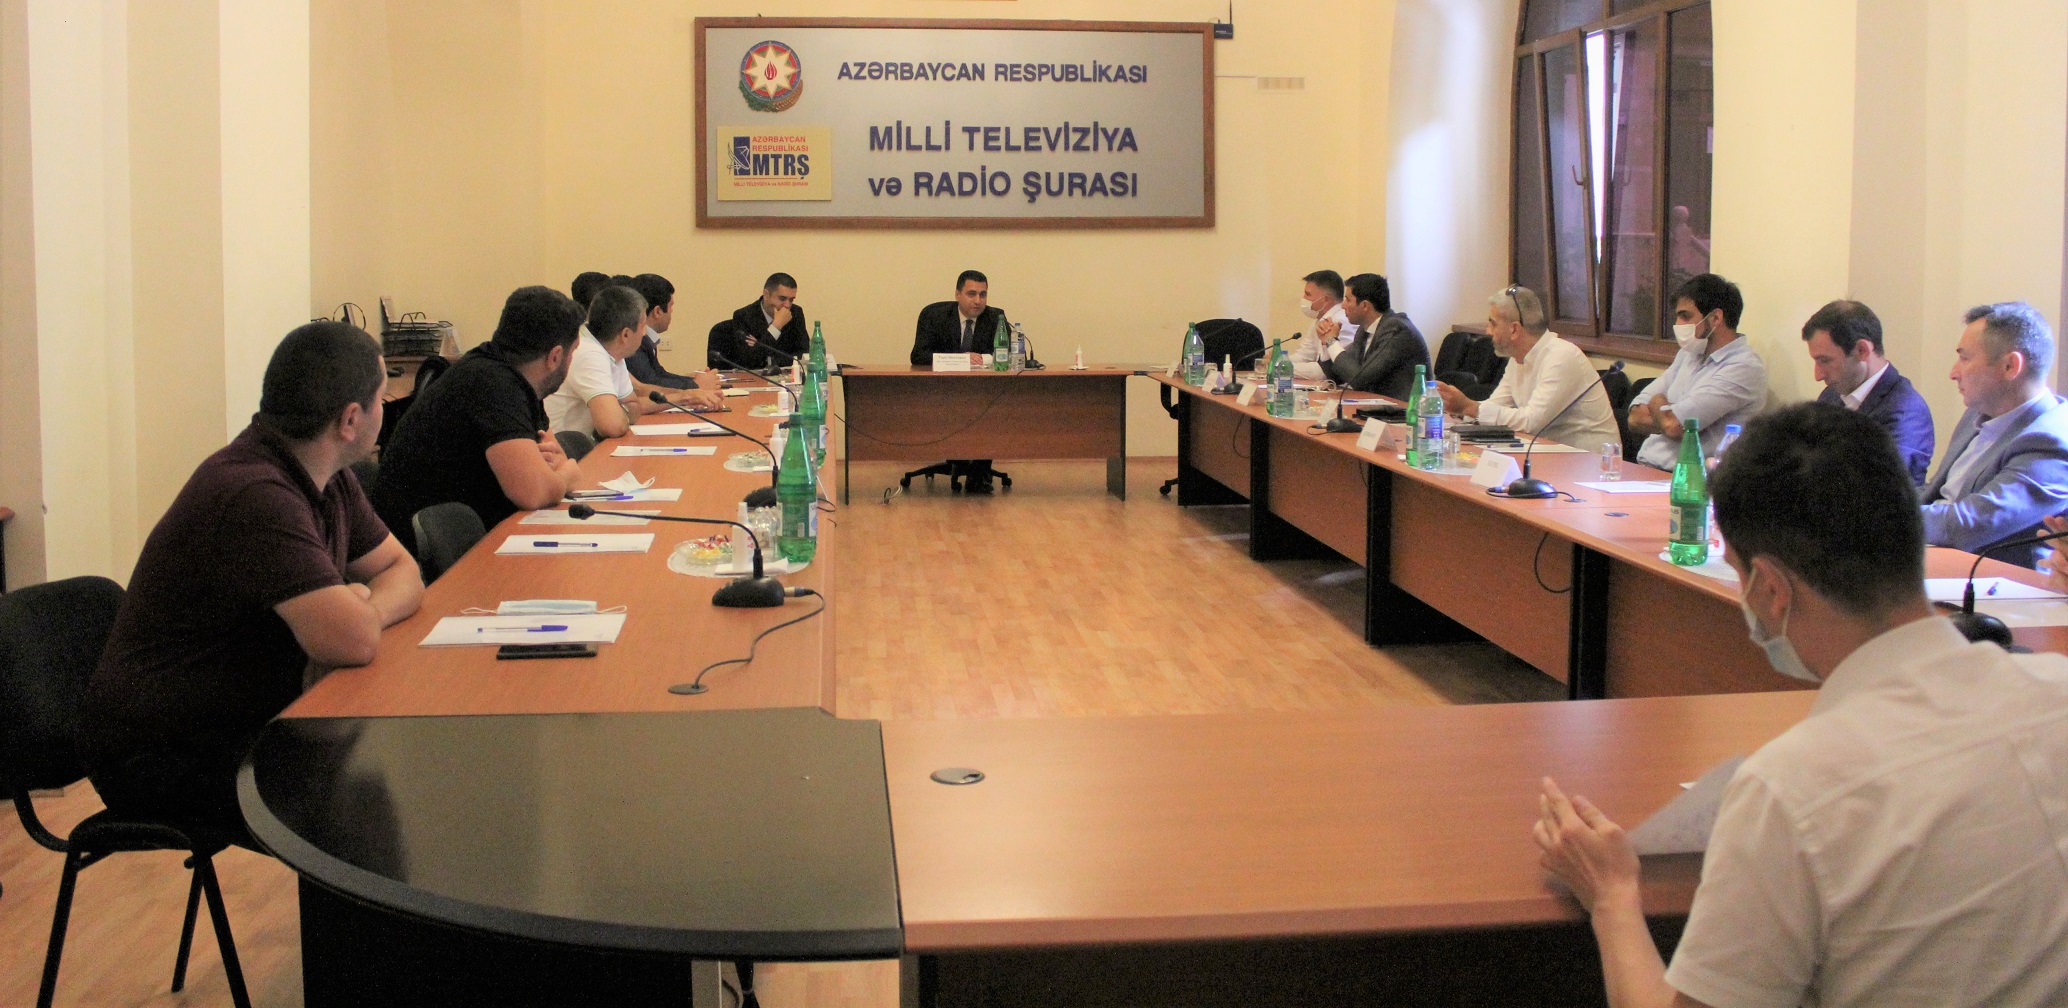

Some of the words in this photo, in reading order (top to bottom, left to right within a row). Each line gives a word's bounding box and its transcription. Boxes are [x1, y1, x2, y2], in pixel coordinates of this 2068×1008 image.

[837, 62, 985, 82] AZƏRBAYCAN
[994, 59, 1148, 84] RESPUBLİKASI
[869, 121, 951, 152] MİLLİ
[962, 121, 1138, 153] TELEVİZİYA
[752, 153, 810, 180] MTRŞ
[868, 178, 903, 197] və
[914, 165, 1012, 198] RADİO
[1022, 170, 1138, 204] ŞURASI
